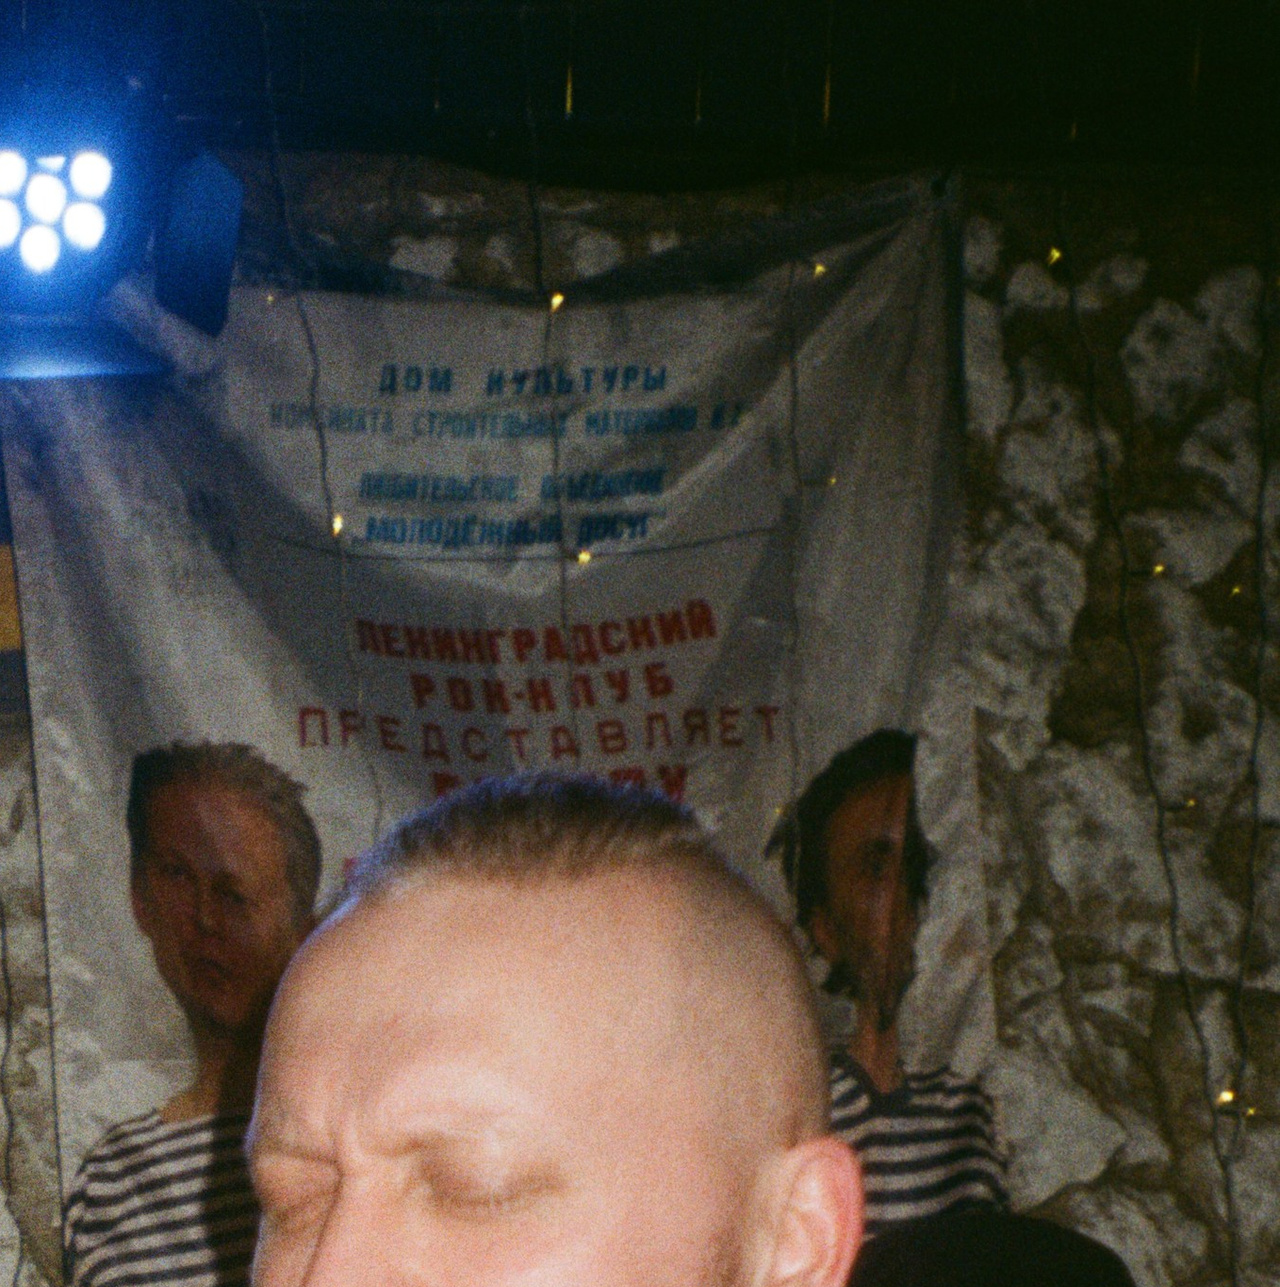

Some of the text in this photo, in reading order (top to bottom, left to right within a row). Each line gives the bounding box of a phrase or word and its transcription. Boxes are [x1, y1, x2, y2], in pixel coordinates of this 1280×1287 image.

[379, 364, 453, 396] ДОМ
[355, 599, 718, 667] ЛЕНИНГРАДСКИЙ
[410, 661, 674, 714] РОК-КЛУБ
[297, 704, 781, 762] ПРЕДСТАВЛЯЕТ
